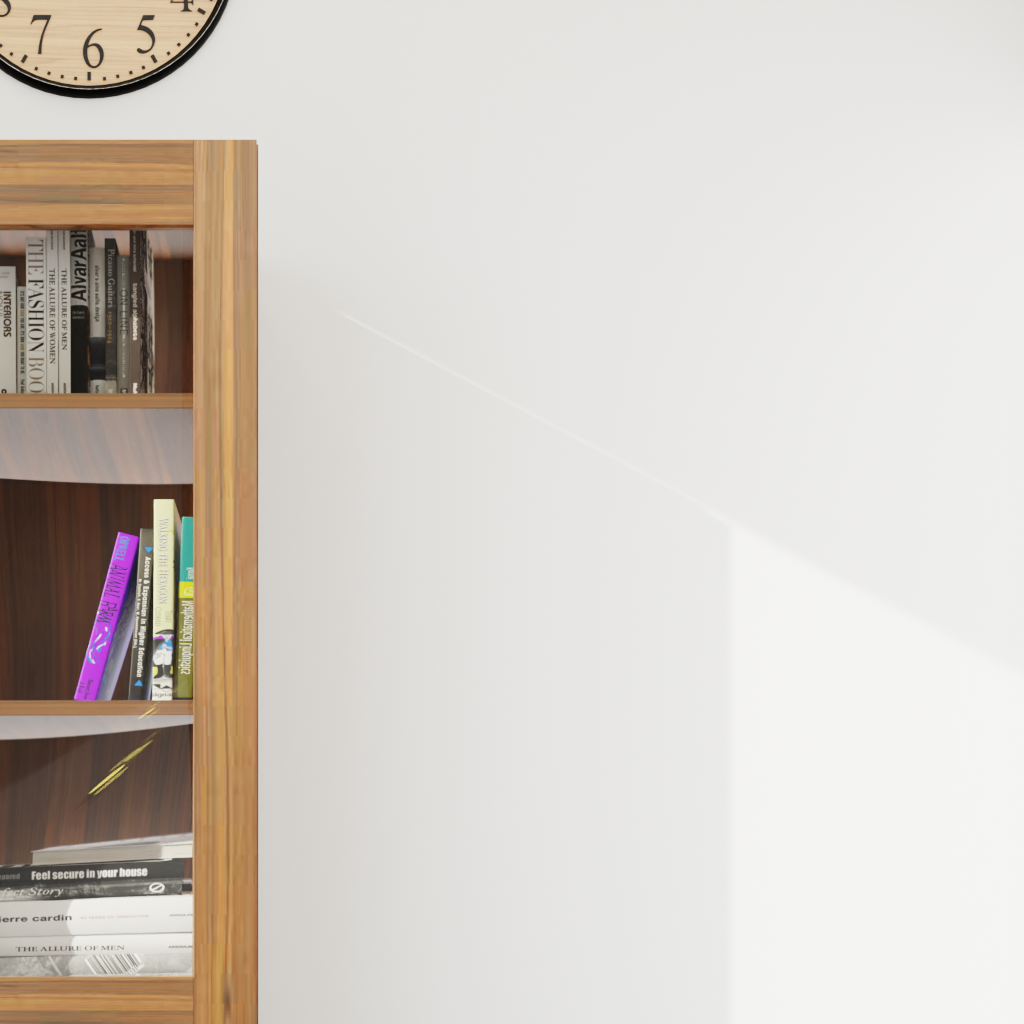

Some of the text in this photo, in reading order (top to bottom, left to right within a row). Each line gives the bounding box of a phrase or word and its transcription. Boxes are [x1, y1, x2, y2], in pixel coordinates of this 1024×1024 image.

[30, 14, 52, 54] 7
[82, 28, 104, 68] 6
[136, 14, 155, 54] 5
[71, 230, 88, 260] Aal
[107, 248, 115, 277] Picasso
[71, 260, 88, 302] Alvar
[107, 278, 115, 308] Guitars
[119, 290, 128, 306] ON
[3, 291, 12, 337] INTERIORS
[27, 239, 44, 393] THE FASHION BOO
[49, 320, 56, 331] OF
[61, 320, 68, 331] OF
[119, 309, 128, 336] LINE
[143, 556, 151, 578] Access
[158, 518, 169, 604] WALKING THE HEXAGON
[96, 536, 130, 623] ORWELL ANIMAL FARM
[140, 585, 149, 616] Expansion
[137, 625, 146, 646] Higher
[136, 647, 144, 677] Education
[31, 870, 50, 881] Feel
[52, 871, 84, 880] secure
[86, 869, 95, 878] in
[96, 869, 117, 880] your
[119, 867, 148, 877] house
[28, 886, 64, 898] Story
[32, 914, 72, 922] cardin
